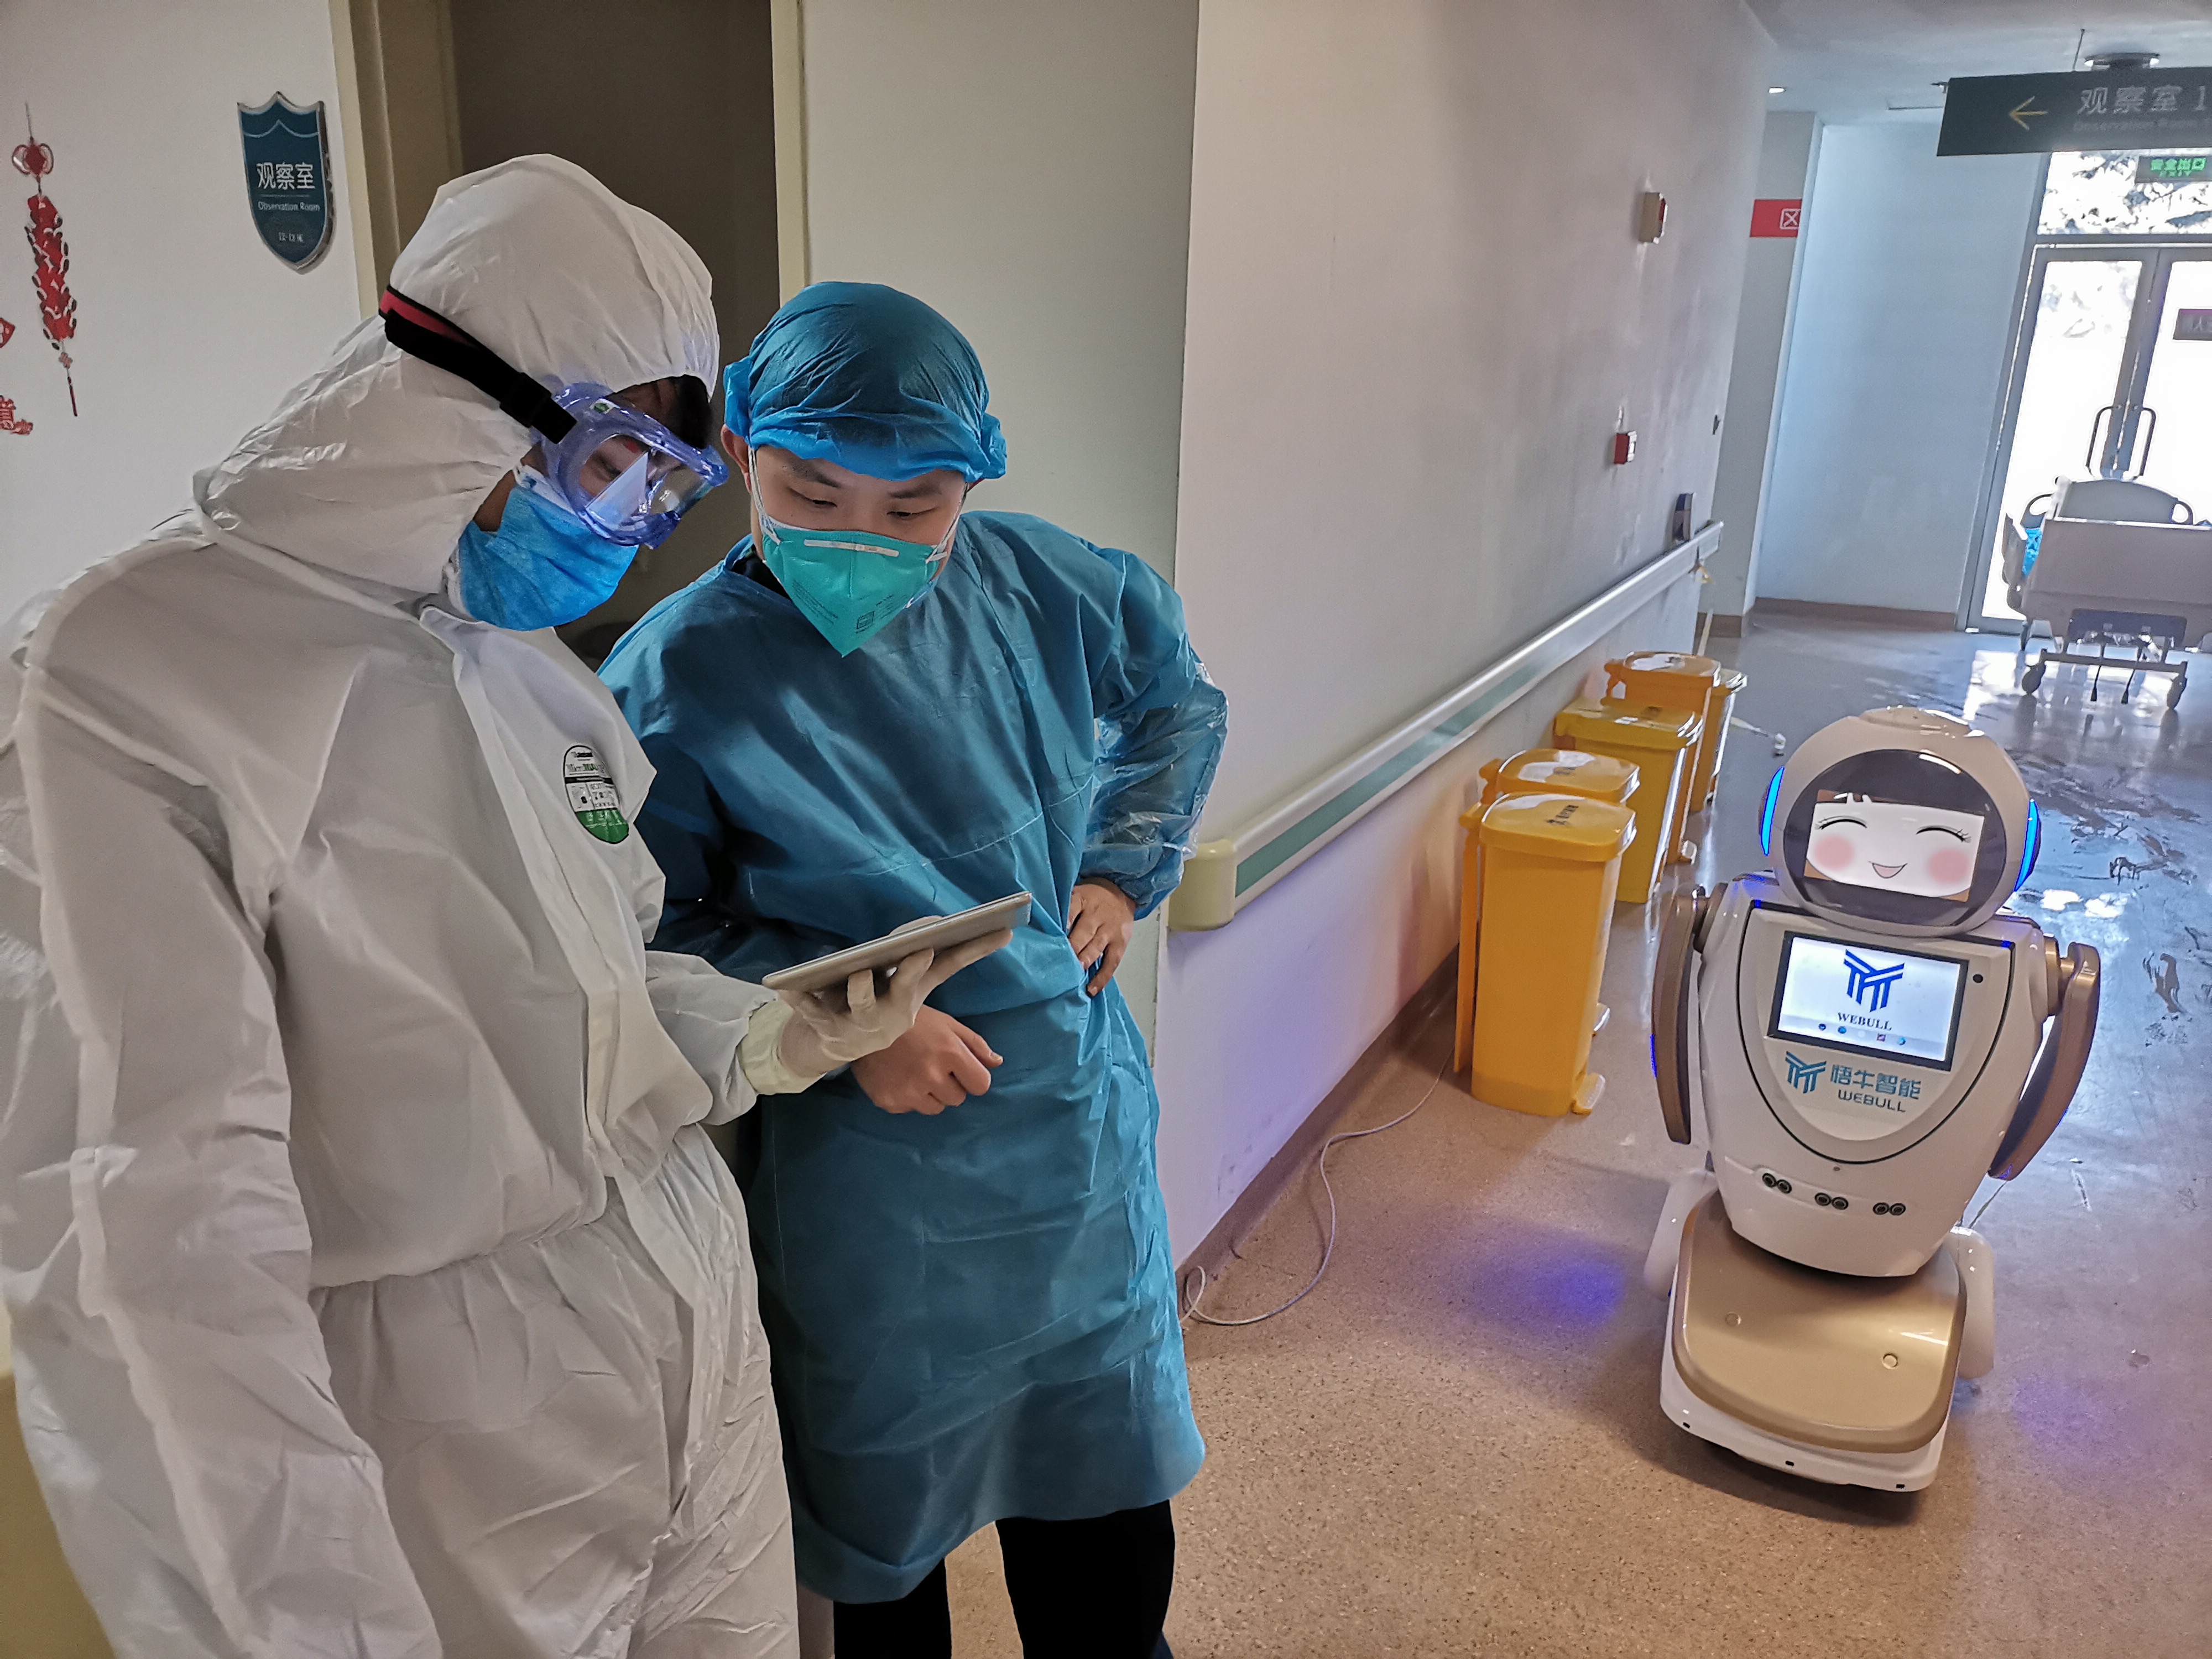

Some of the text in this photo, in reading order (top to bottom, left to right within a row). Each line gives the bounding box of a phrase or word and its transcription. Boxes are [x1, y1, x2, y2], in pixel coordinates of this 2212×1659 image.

[256, 161, 316, 190] 观察室
[257, 201, 321, 211] Observation Room
[1838, 1013, 1892, 1031] WEBULL
[1830, 1065, 1921, 1099] 悟牛智能
[1838, 1089, 1906, 1113] WEBULL
